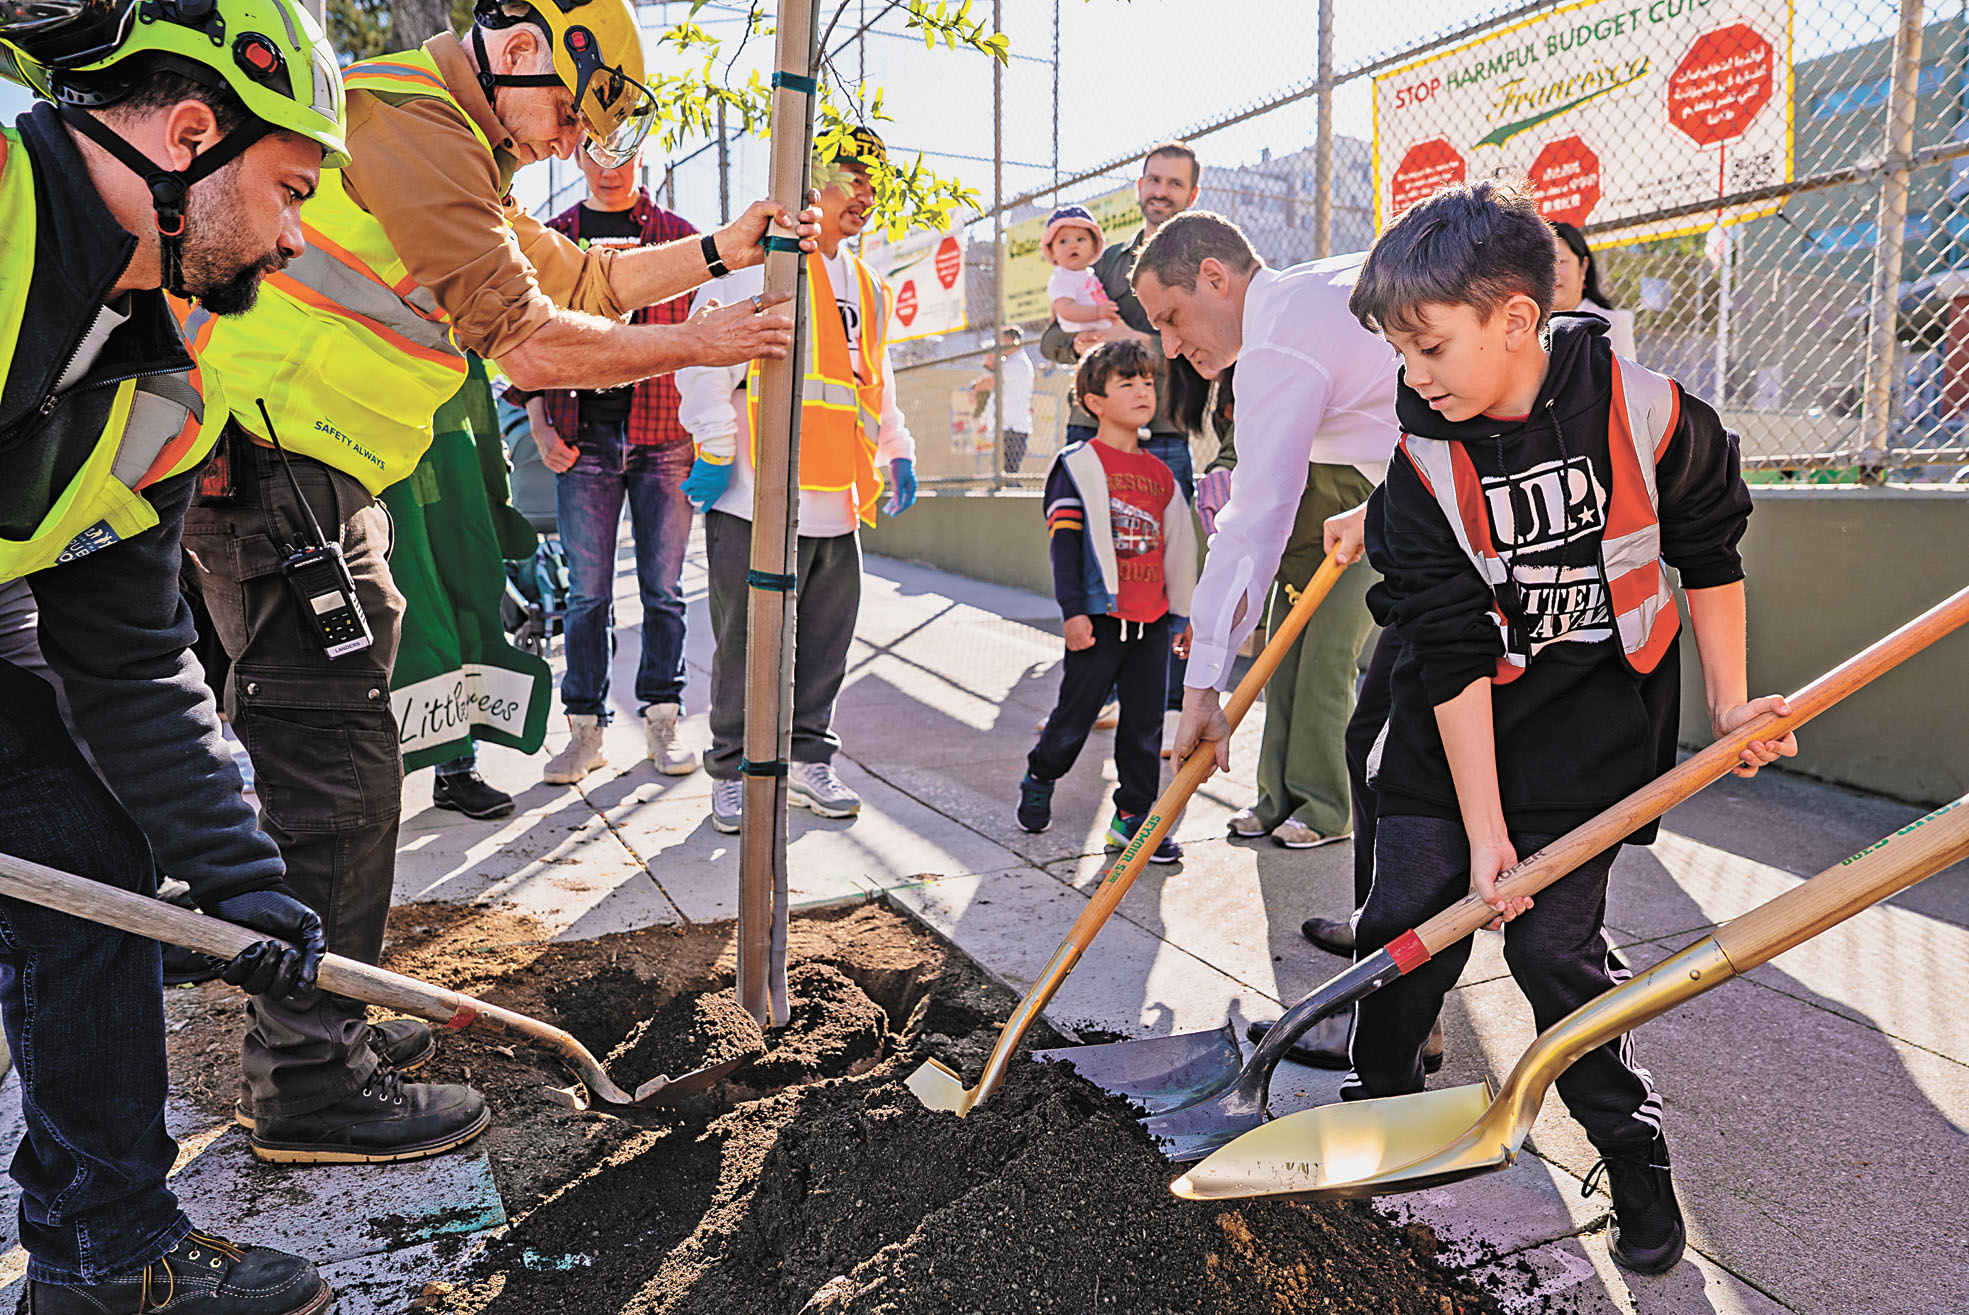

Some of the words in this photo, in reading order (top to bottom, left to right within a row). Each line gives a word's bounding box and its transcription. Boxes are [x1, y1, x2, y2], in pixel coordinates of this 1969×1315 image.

[1395, 78, 1441, 109] STOP
[1447, 44, 1540, 92] HARMFUL
[1546, 8, 1642, 57] BUDGET
[314, 420, 353, 447] SAFETY
[334, 641, 361, 654] LANDERS
[1121, 814, 1161, 862] SEYMOUR
